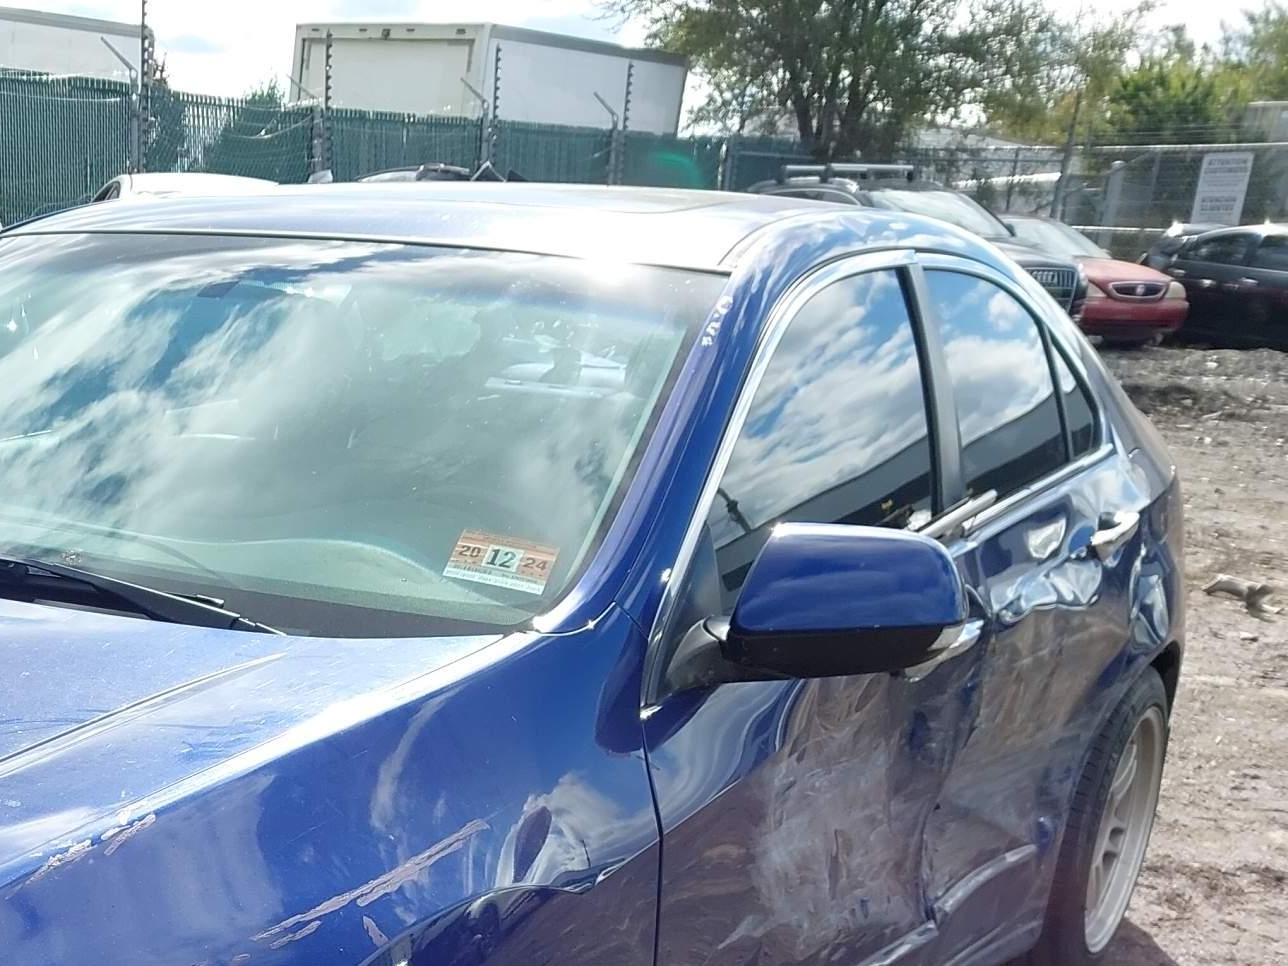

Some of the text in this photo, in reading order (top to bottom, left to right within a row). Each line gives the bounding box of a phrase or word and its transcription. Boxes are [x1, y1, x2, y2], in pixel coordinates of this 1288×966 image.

[458, 544, 548, 571] 20 12 24
